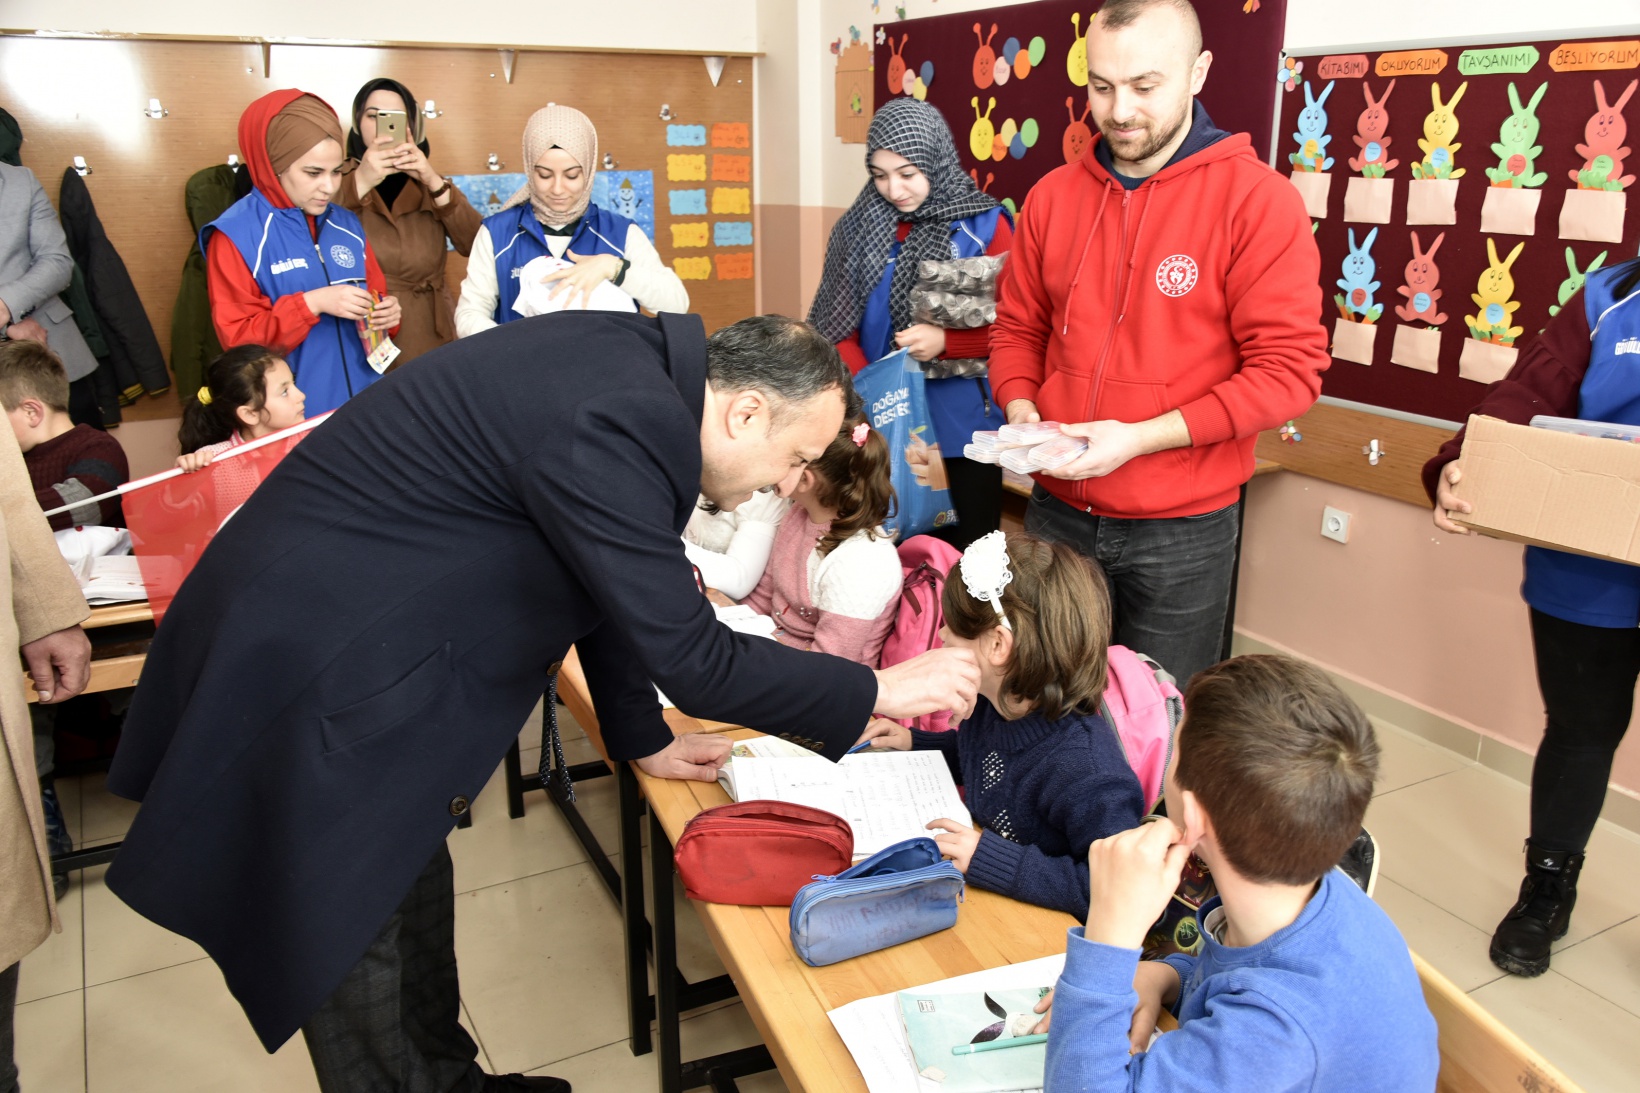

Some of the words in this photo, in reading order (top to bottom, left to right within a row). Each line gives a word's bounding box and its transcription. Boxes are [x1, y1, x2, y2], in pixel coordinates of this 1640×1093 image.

[1320, 60, 1364, 75] KİTABIMI
[1381, 57, 1441, 72] OKUYORUM
[1462, 52, 1531, 69] TAVŞANIMI
